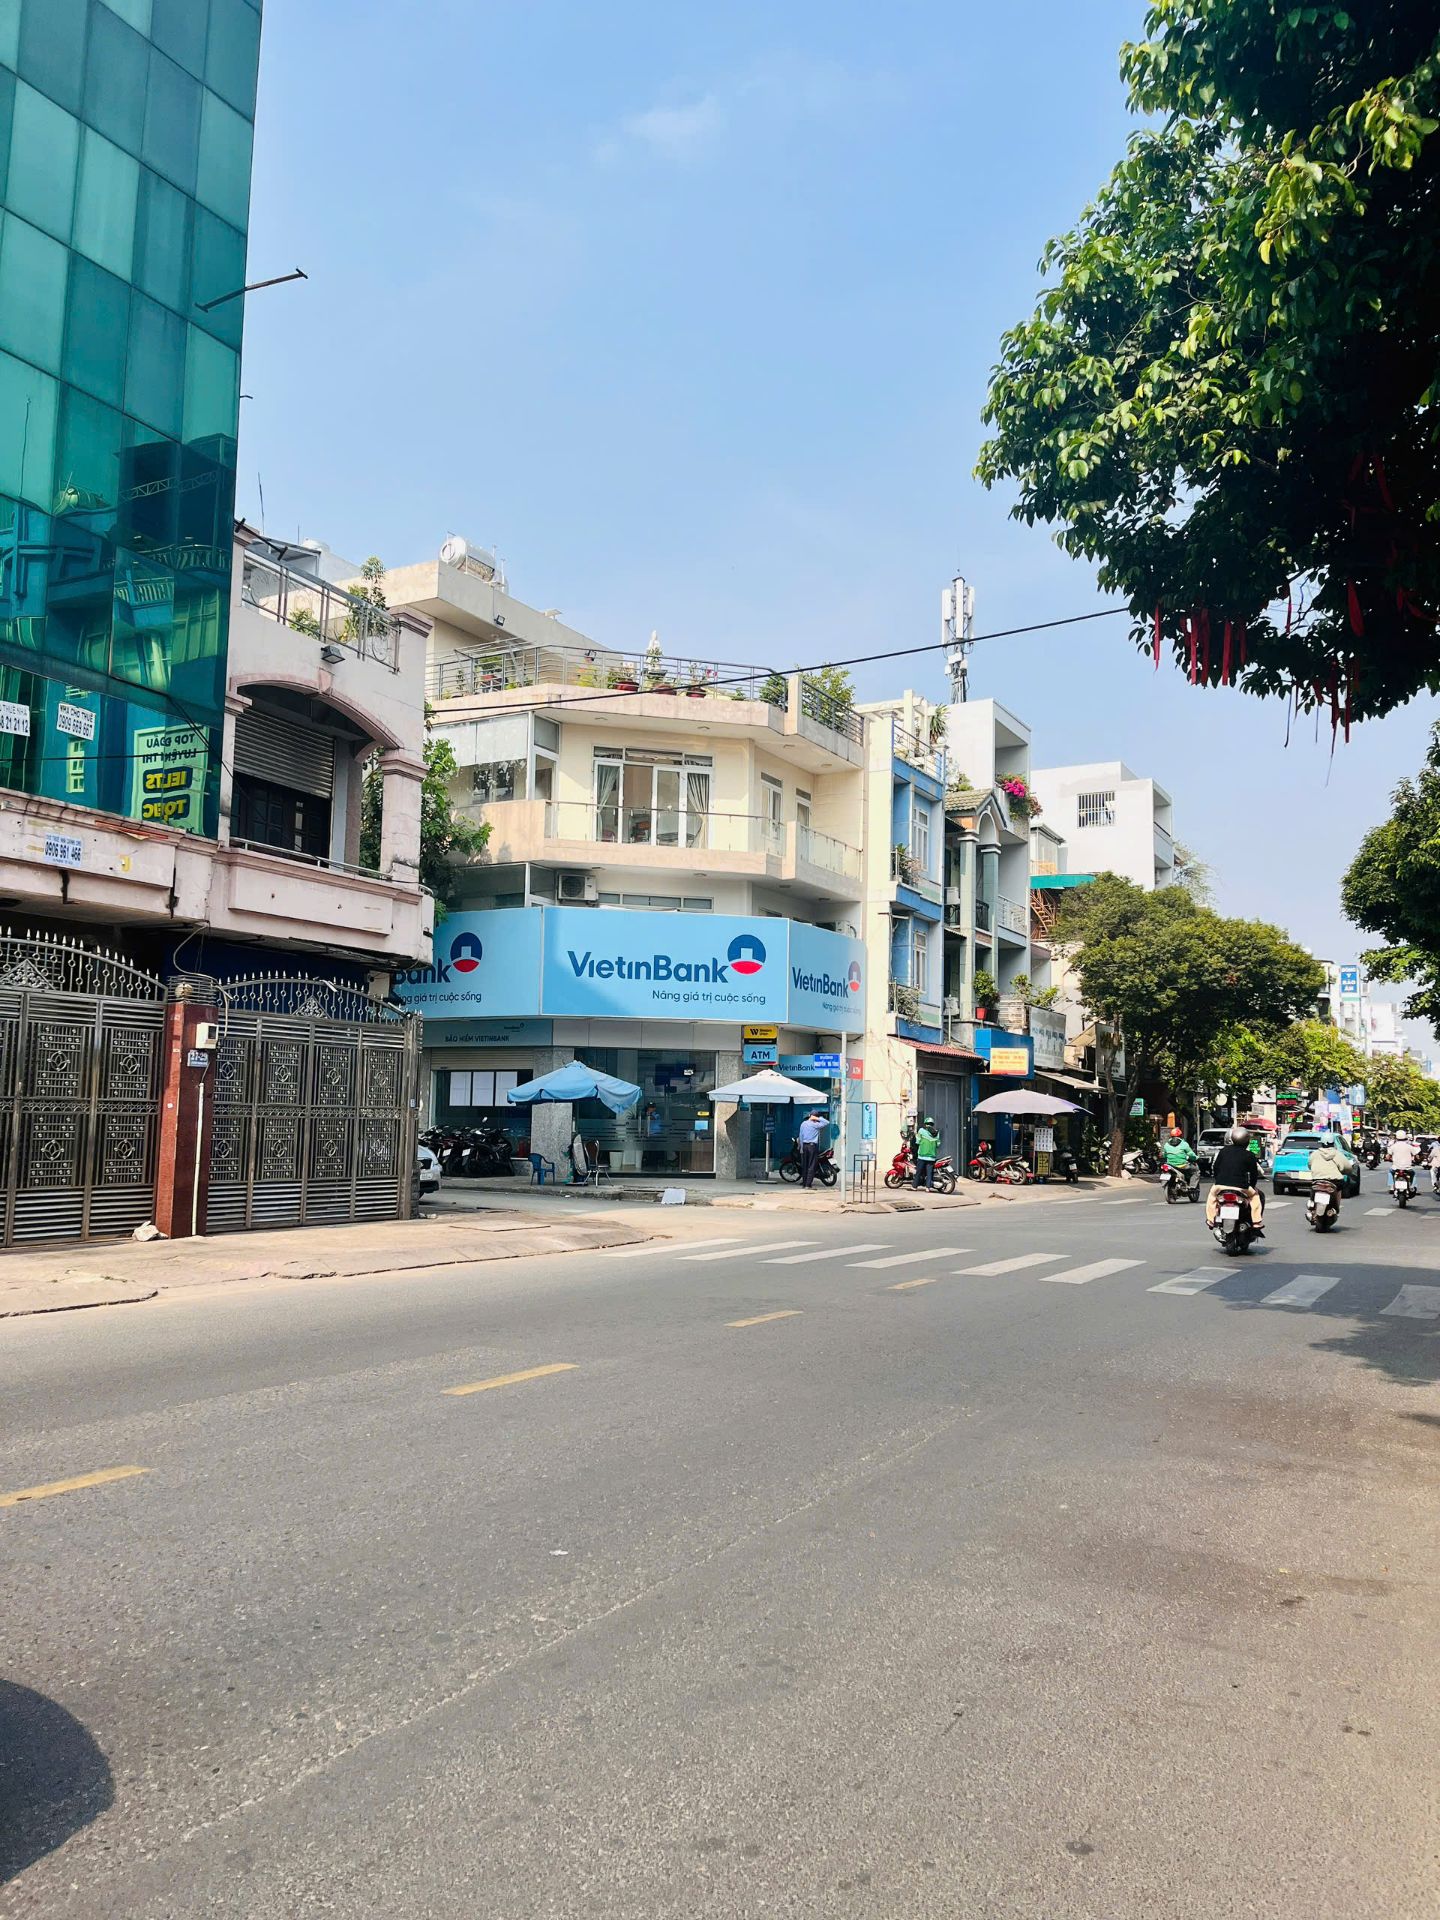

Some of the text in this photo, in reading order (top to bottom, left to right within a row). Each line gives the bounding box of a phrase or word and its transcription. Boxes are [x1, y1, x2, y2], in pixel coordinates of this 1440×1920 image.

[567, 951, 729, 984] VietinBank
[792, 966, 849, 999] VietinBank
[439, 992, 459, 1004] cuộc
[460, 990, 482, 1003] sống
[652, 990, 766, 1006] Nâng giá trị cuộc sống
[751, 1051, 770, 1060] ATM
[779, 1064, 815, 1072] VietinBank
